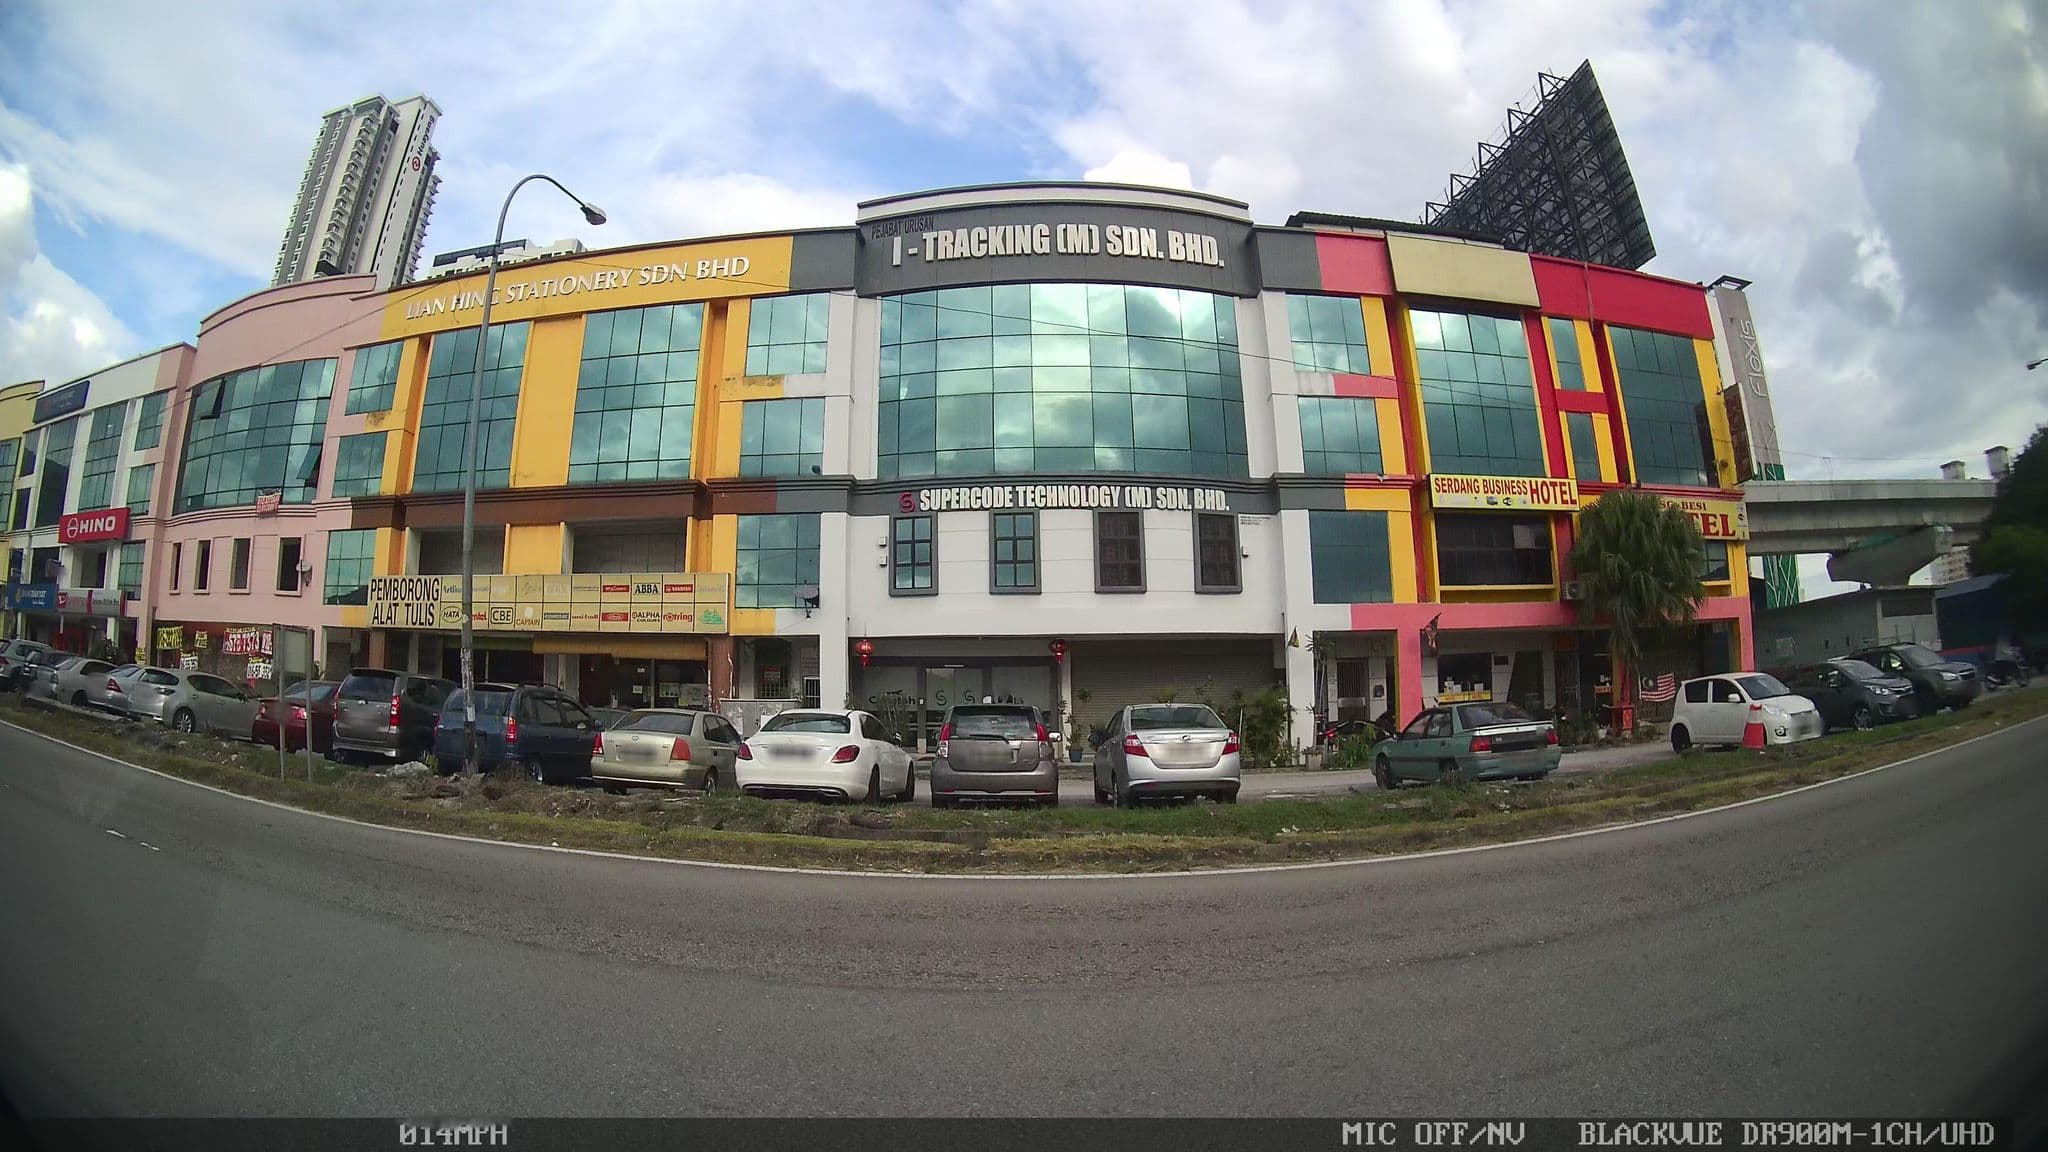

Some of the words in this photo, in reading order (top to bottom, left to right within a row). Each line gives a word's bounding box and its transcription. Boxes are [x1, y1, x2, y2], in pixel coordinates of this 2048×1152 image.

[871, 220, 904, 240] PEJABAT
[904, 216, 935, 234] URUSAN
[922, 223, 1051, 262] TRACKING
[1056, 223, 1100, 254] (M)
[1105, 224, 1165, 259] SDN.
[1167, 230, 1225, 267] BHD.
[406, 298, 447, 320] LIAN
[506, 267, 635, 304] STATIONERY
[639, 262, 688, 286] SDN
[696, 256, 750, 280] BHD
[919, 486, 1014, 512] SUPERCODE
[1015, 484, 1121, 509] TECHNOLOGY
[1124, 486, 1152, 508] (M)
[1155, 486, 1192, 511] SDN.
[1193, 488, 1230, 511] BHD.
[1434, 477, 1480, 494] SERDANG
[1483, 479, 1528, 495] BUSINESS
[1528, 480, 1578, 505] HOTEL
[1681, 501, 1707, 511] BESI
[79, 515, 117, 533] HINO
[370, 577, 440, 601] PEMBORONG
[634, 584, 659, 594] ABBA
[371, 602, 400, 625] ALAT
[404, 602, 435, 626] TULIS
[443, 610, 460, 618] HATA
[492, 610, 511, 622] CBE
